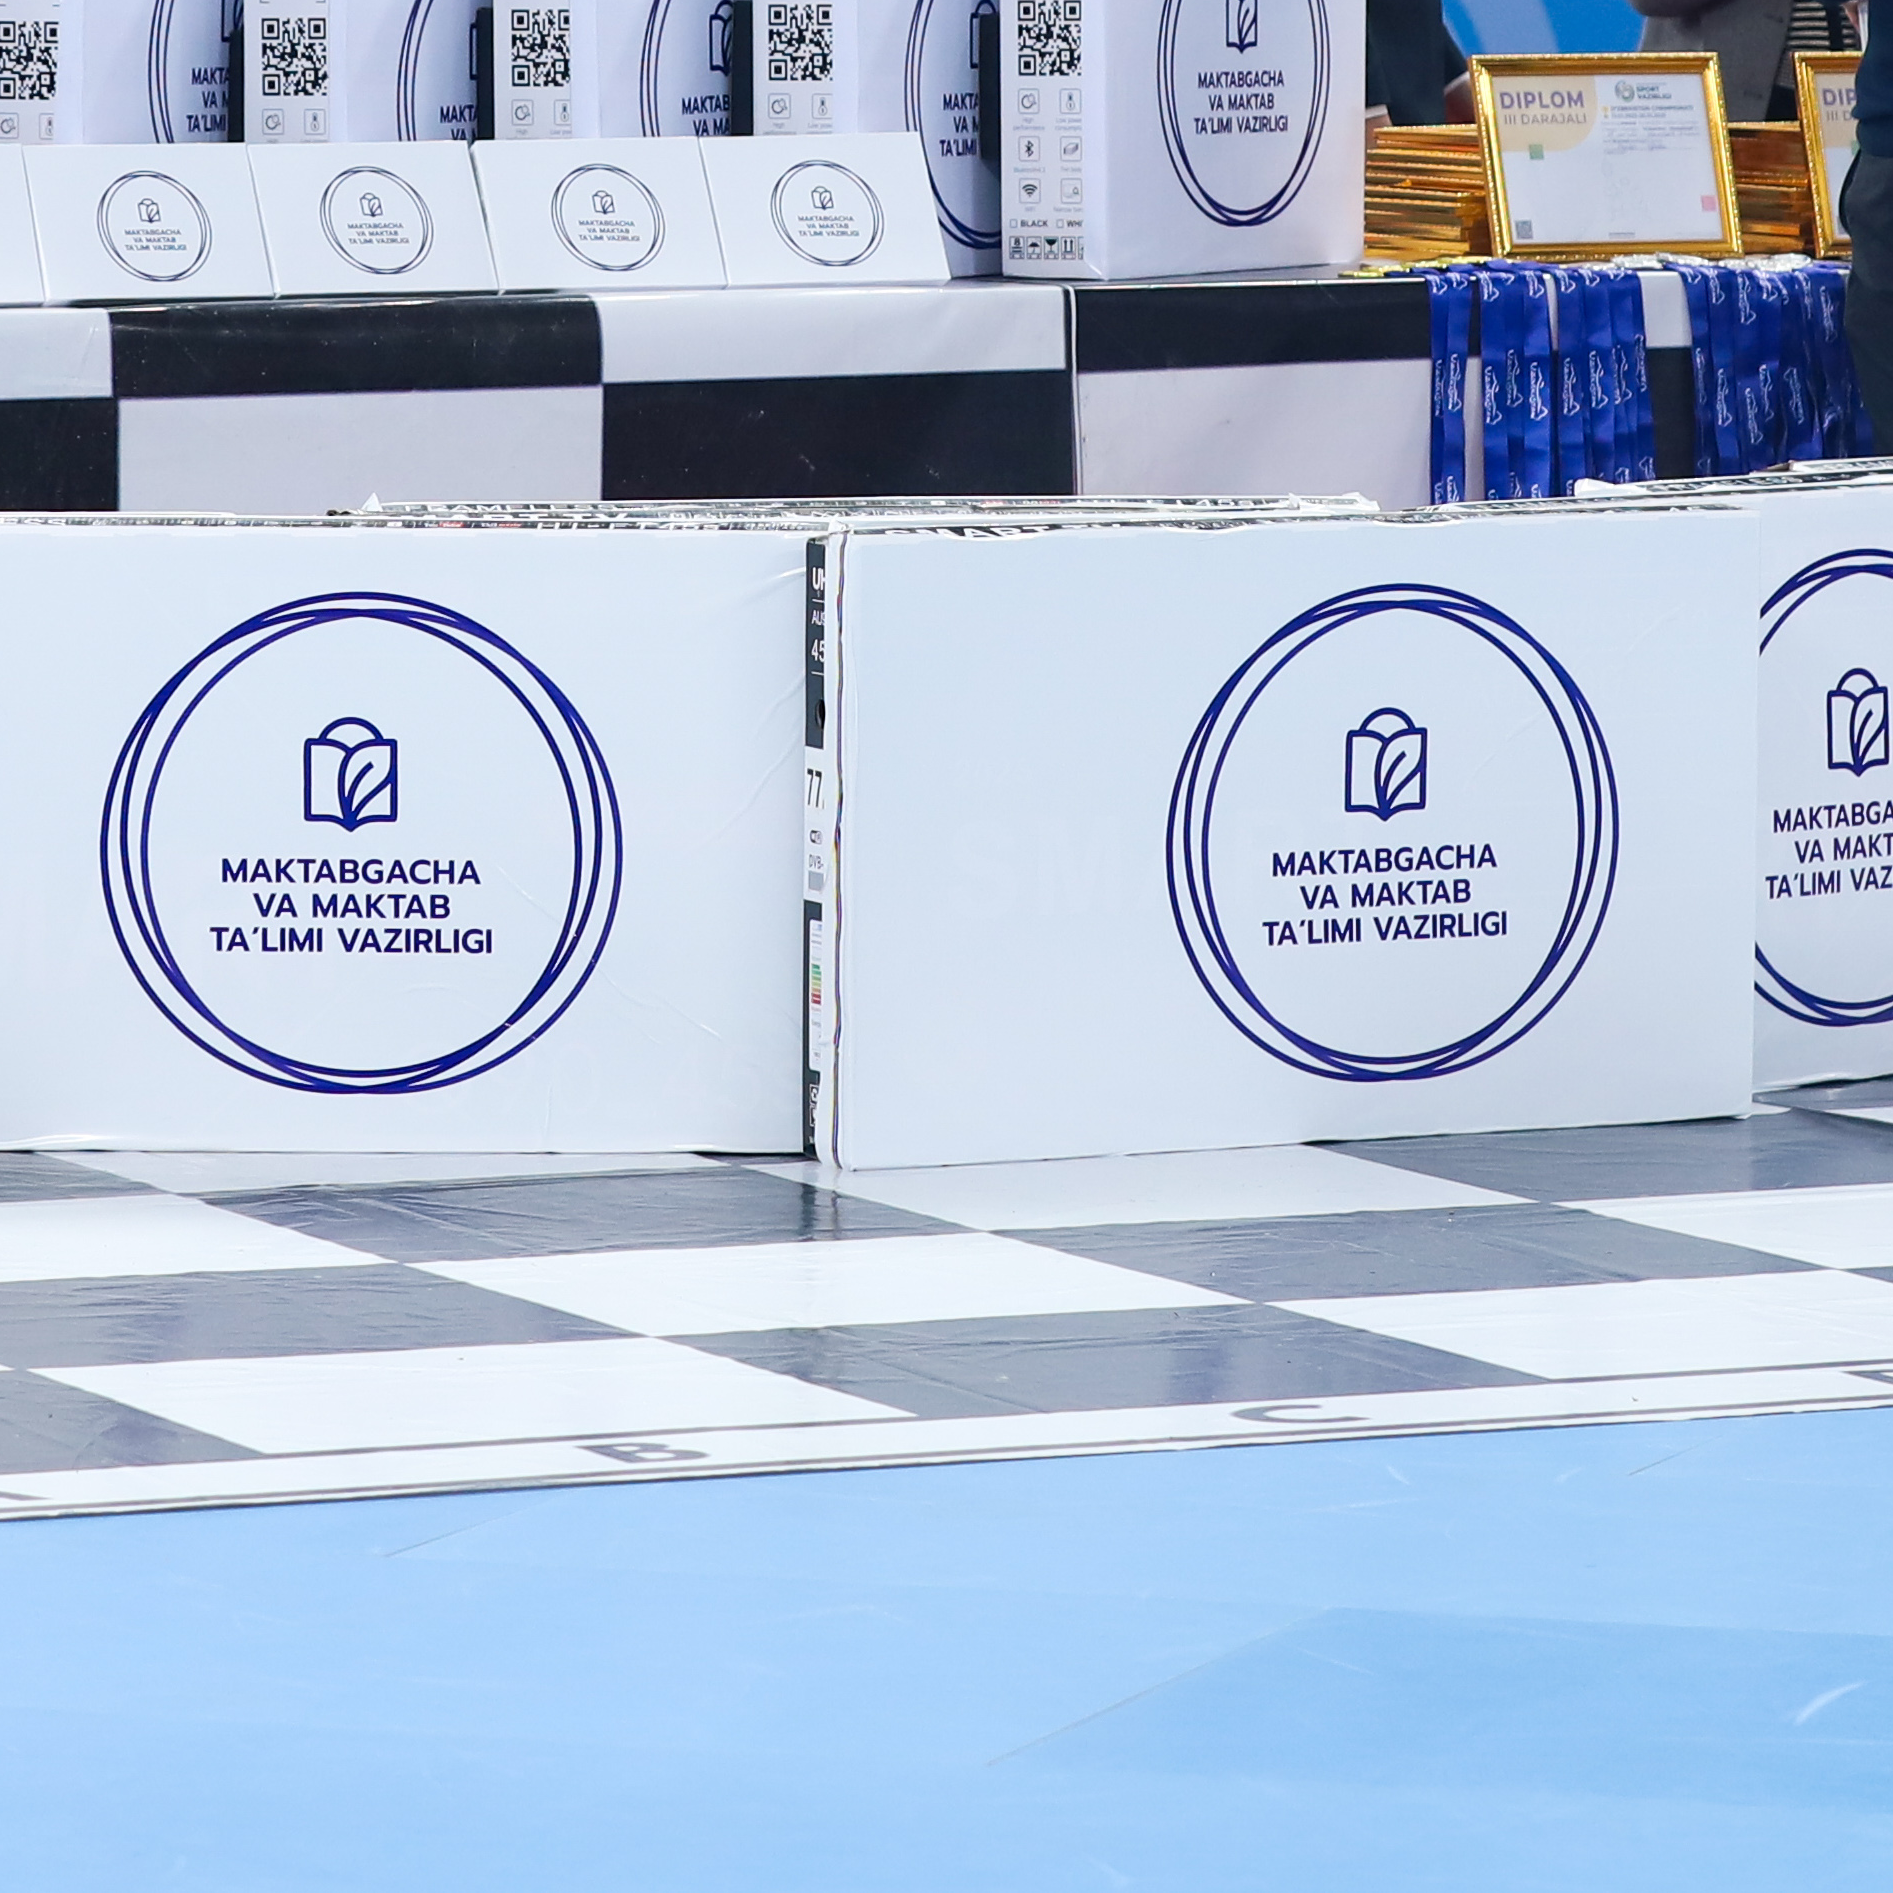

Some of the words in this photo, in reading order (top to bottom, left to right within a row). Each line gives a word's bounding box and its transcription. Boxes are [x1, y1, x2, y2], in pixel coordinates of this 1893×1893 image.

[1198, 70, 1284, 88] MAKTABGACHA
[202, 91, 218, 108] VA
[1209, 95, 1224, 111] VA
[1228, 93, 1274, 110] MAKTAB
[1500, 91, 1584, 109] DIPLOM
[693, 119, 710, 137] VA
[954, 116, 969, 133] VA
[1237, 115, 1288, 133] VAZIRLIGI
[1521, 113, 1587, 125] DARAJALI
[1273, 844, 1497, 877] MAKTABGACHA
[1795, 839, 1824, 863] VA
[222, 858, 480, 884] MAKTABGACHA
[1300, 885, 1339, 909] VA
[1352, 879, 1471, 907] MAKTAB
[1766, 870, 1840, 899] TA'LIMI
[253, 893, 297, 917] VA
[313, 894, 450, 918] MAKTAB
[210, 927, 322, 952] TA'LIMI
[338, 928, 492, 953] VAZIRLIGI
[1262, 918, 1361, 946] TA'LIMI
[1374, 911, 1506, 940] VAZIRLIGI
[580, 1442, 707, 1463] B
[1231, 1403, 1367, 1424] C
